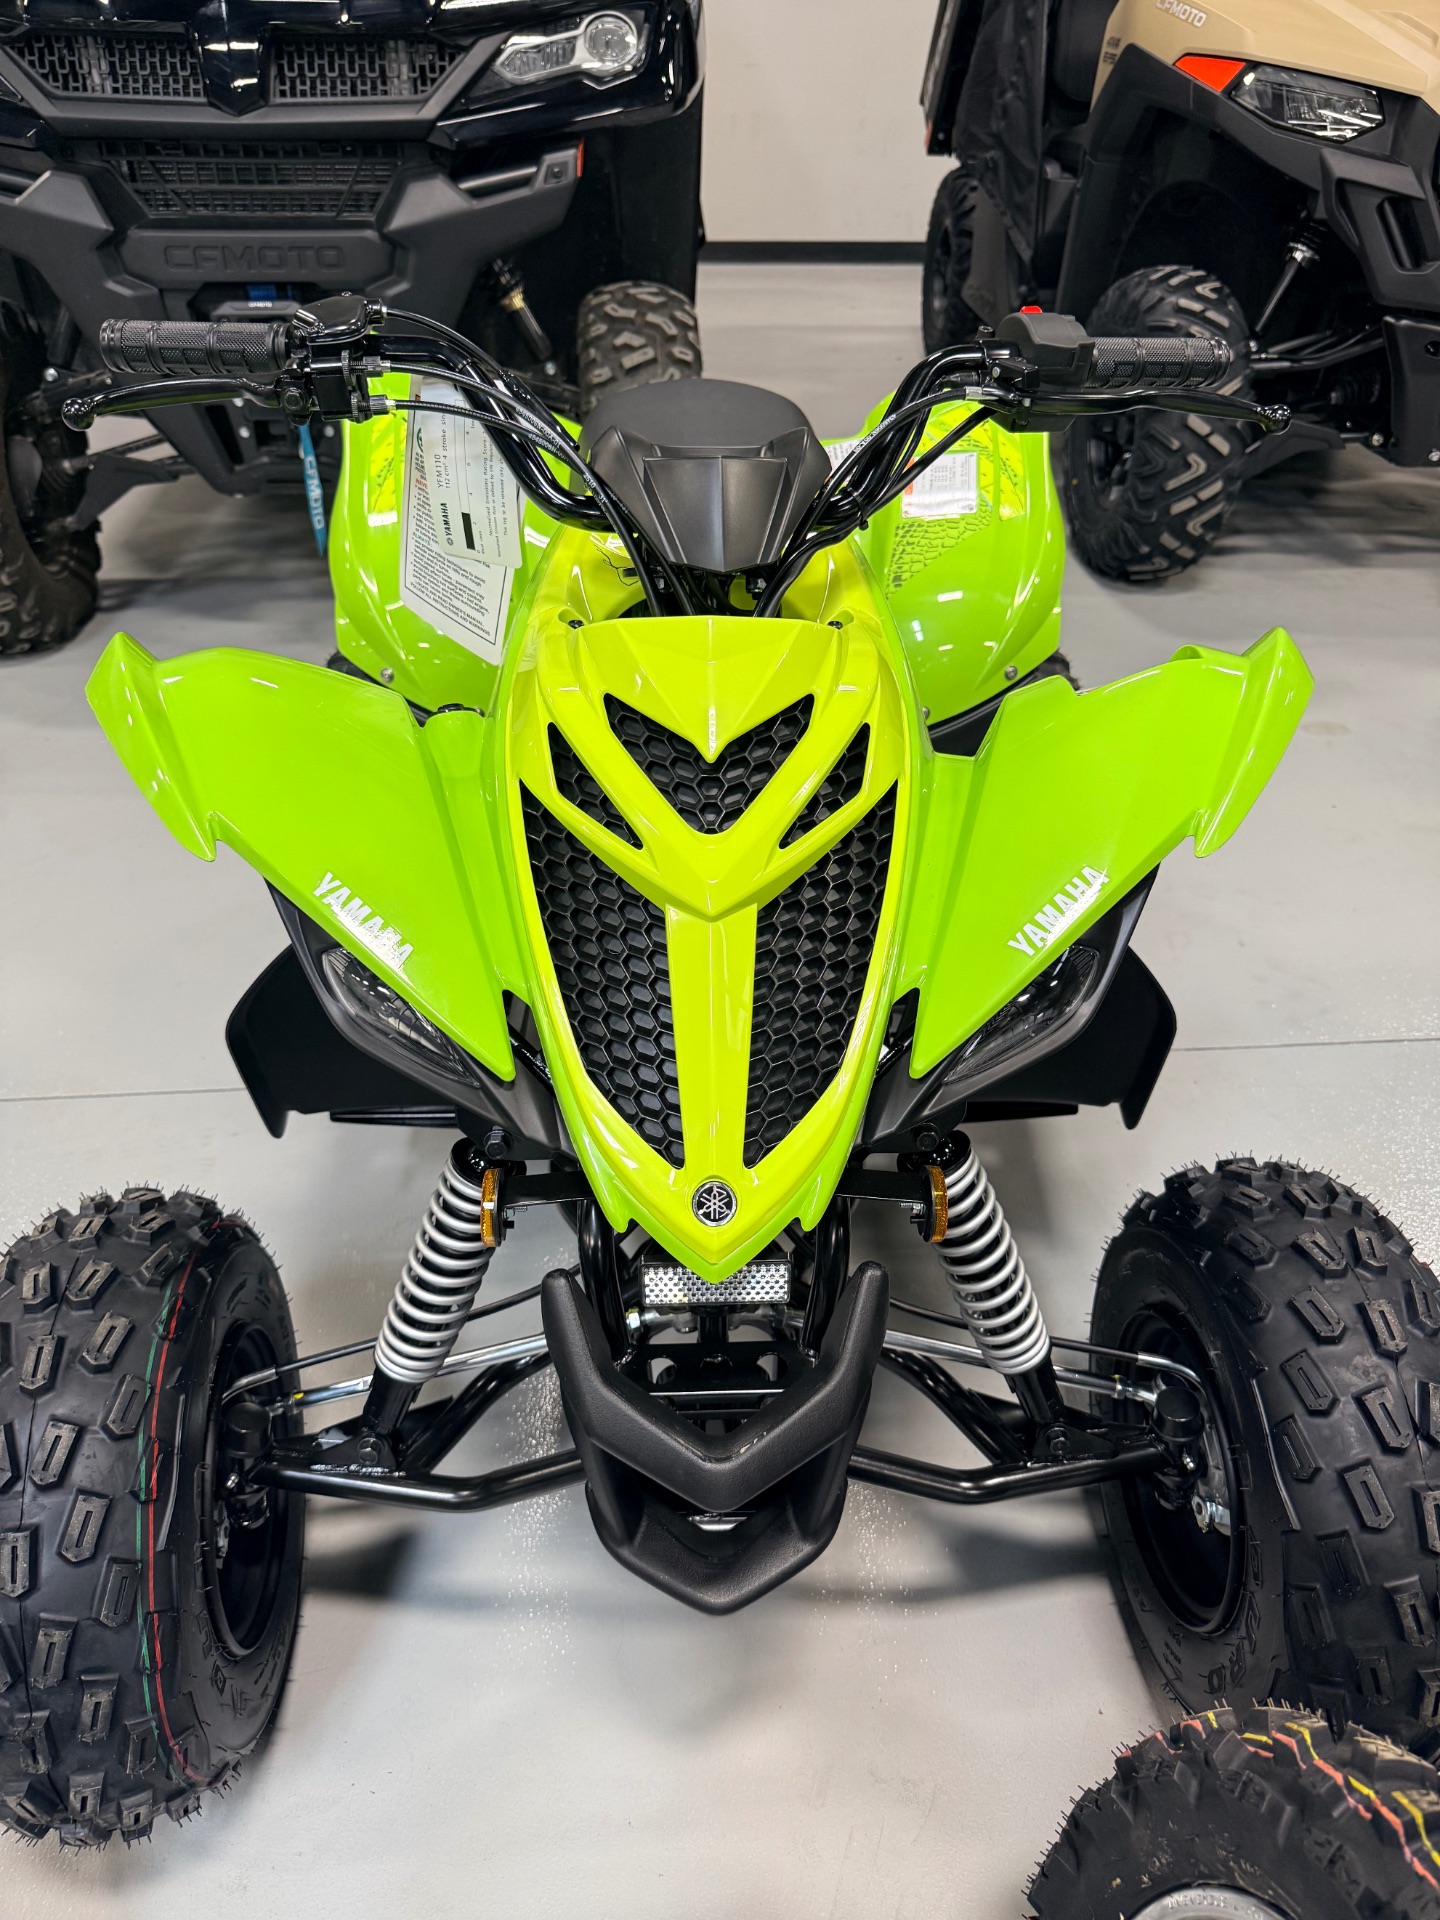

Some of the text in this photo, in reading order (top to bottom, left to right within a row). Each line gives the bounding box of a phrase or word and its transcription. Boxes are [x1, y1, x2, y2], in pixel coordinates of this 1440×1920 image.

[165, 245, 347, 272] CFMOTO
[304, 455, 325, 530] CFMOTO
[440, 502, 453, 537] YAMAHA
[313, 871, 415, 971] YAMAHA
[1007, 866, 1110, 957] YAMAHA
